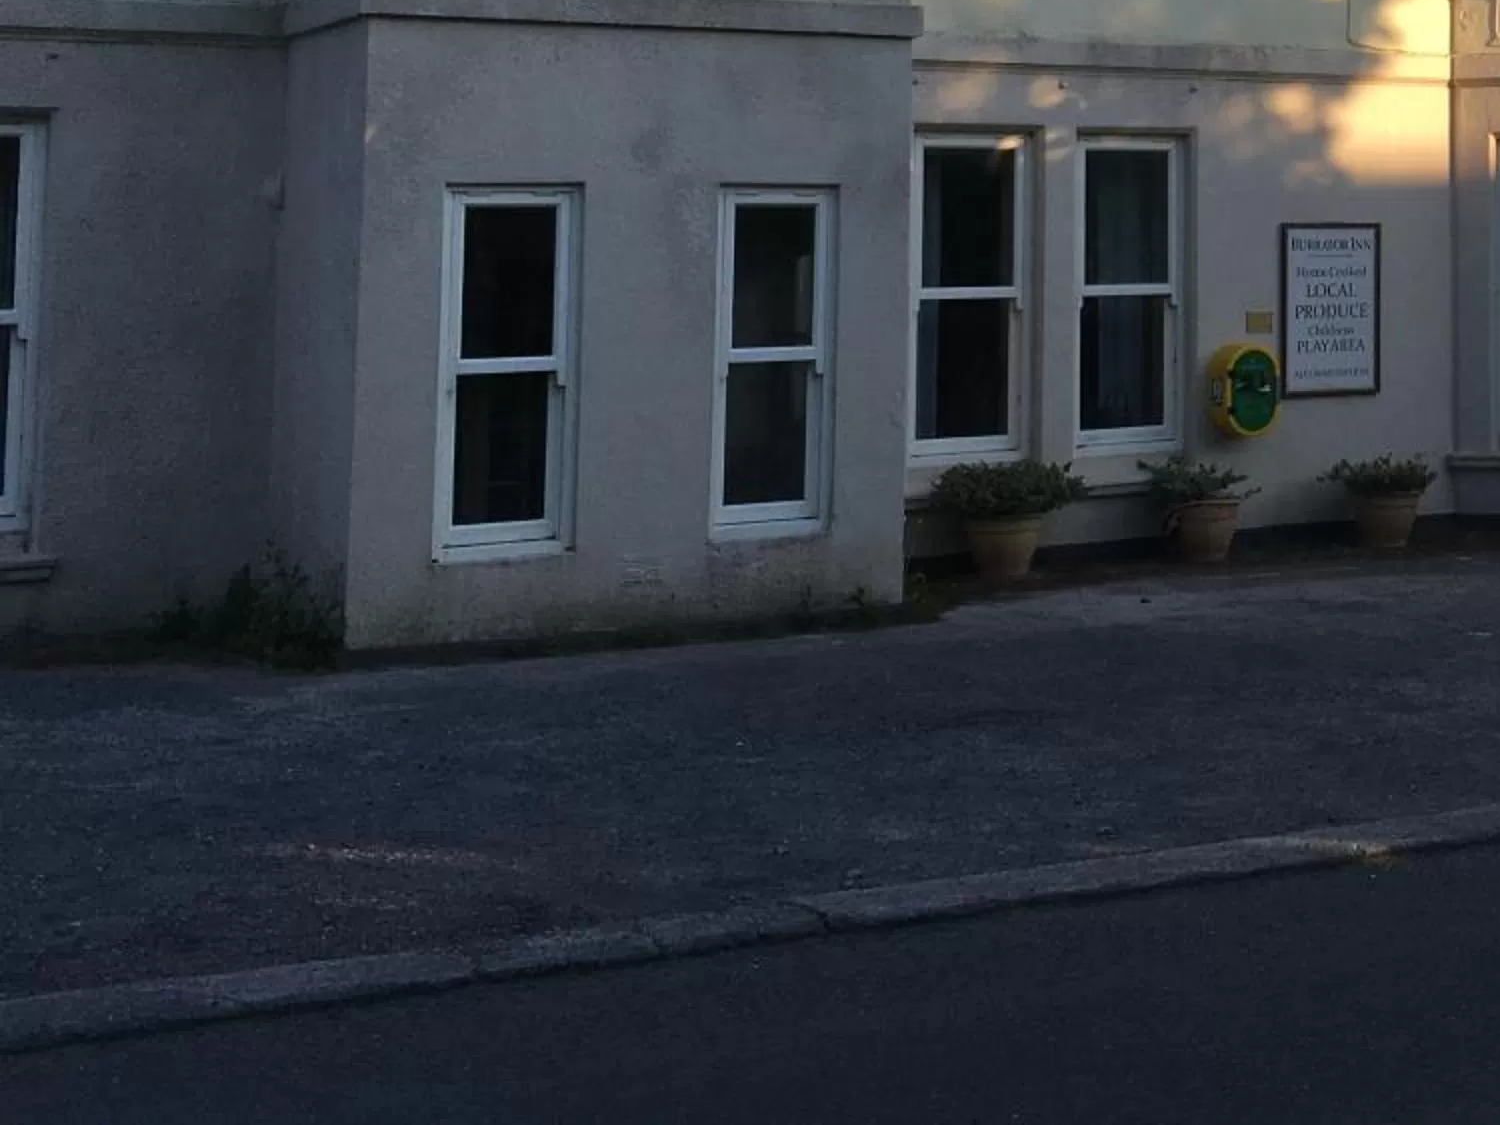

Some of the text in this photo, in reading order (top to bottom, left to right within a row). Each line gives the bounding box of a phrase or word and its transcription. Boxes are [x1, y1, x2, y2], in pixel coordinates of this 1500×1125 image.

[1306, 282, 1357, 298] LOCAL
[1295, 302, 1369, 320] PRODUCE
[1297, 338, 1366, 354] PLAY AREA
